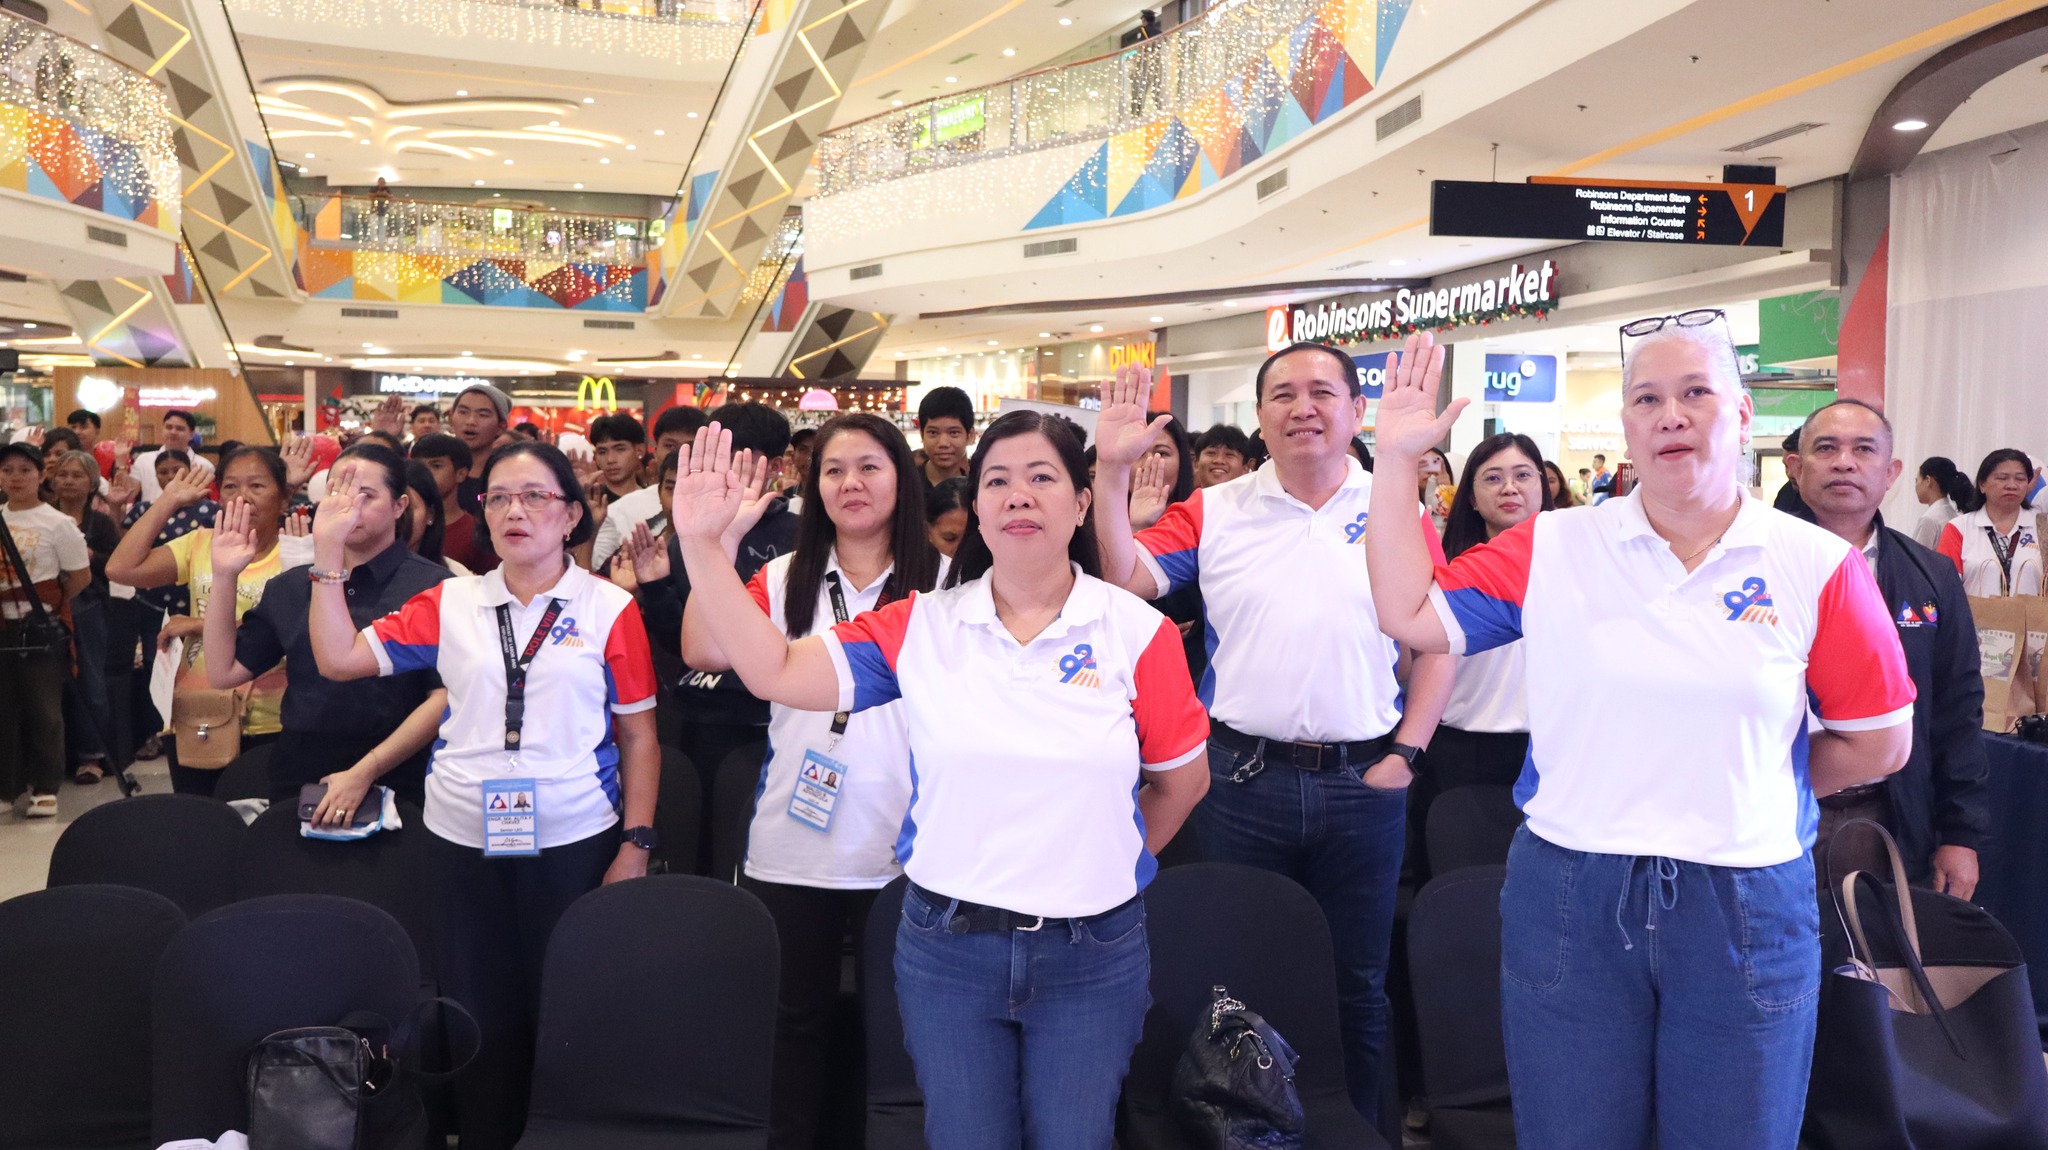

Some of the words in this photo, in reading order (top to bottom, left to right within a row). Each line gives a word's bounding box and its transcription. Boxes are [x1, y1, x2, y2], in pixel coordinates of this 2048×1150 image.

[1575, 188, 1618, 200] Robinsons
[1620, 190, 1667, 202] Department
[1669, 193, 1691, 203] Store
[1744, 189, 1754, 212] 1
[1590, 200, 1633, 212] Robinsons
[1634, 203, 1686, 214] Supermarket
[1600, 214, 1648, 226] Information
[1650, 216, 1685, 227] Counter
[1607, 227, 1640, 238] Elevator
[1646, 229, 1684, 240] Staircase
[1292, 299, 1392, 341] Robinsons
[1396, 259, 1554, 325] Supermarket
[525, 629, 547, 656] DOLE
[543, 611, 557, 631] VIII
